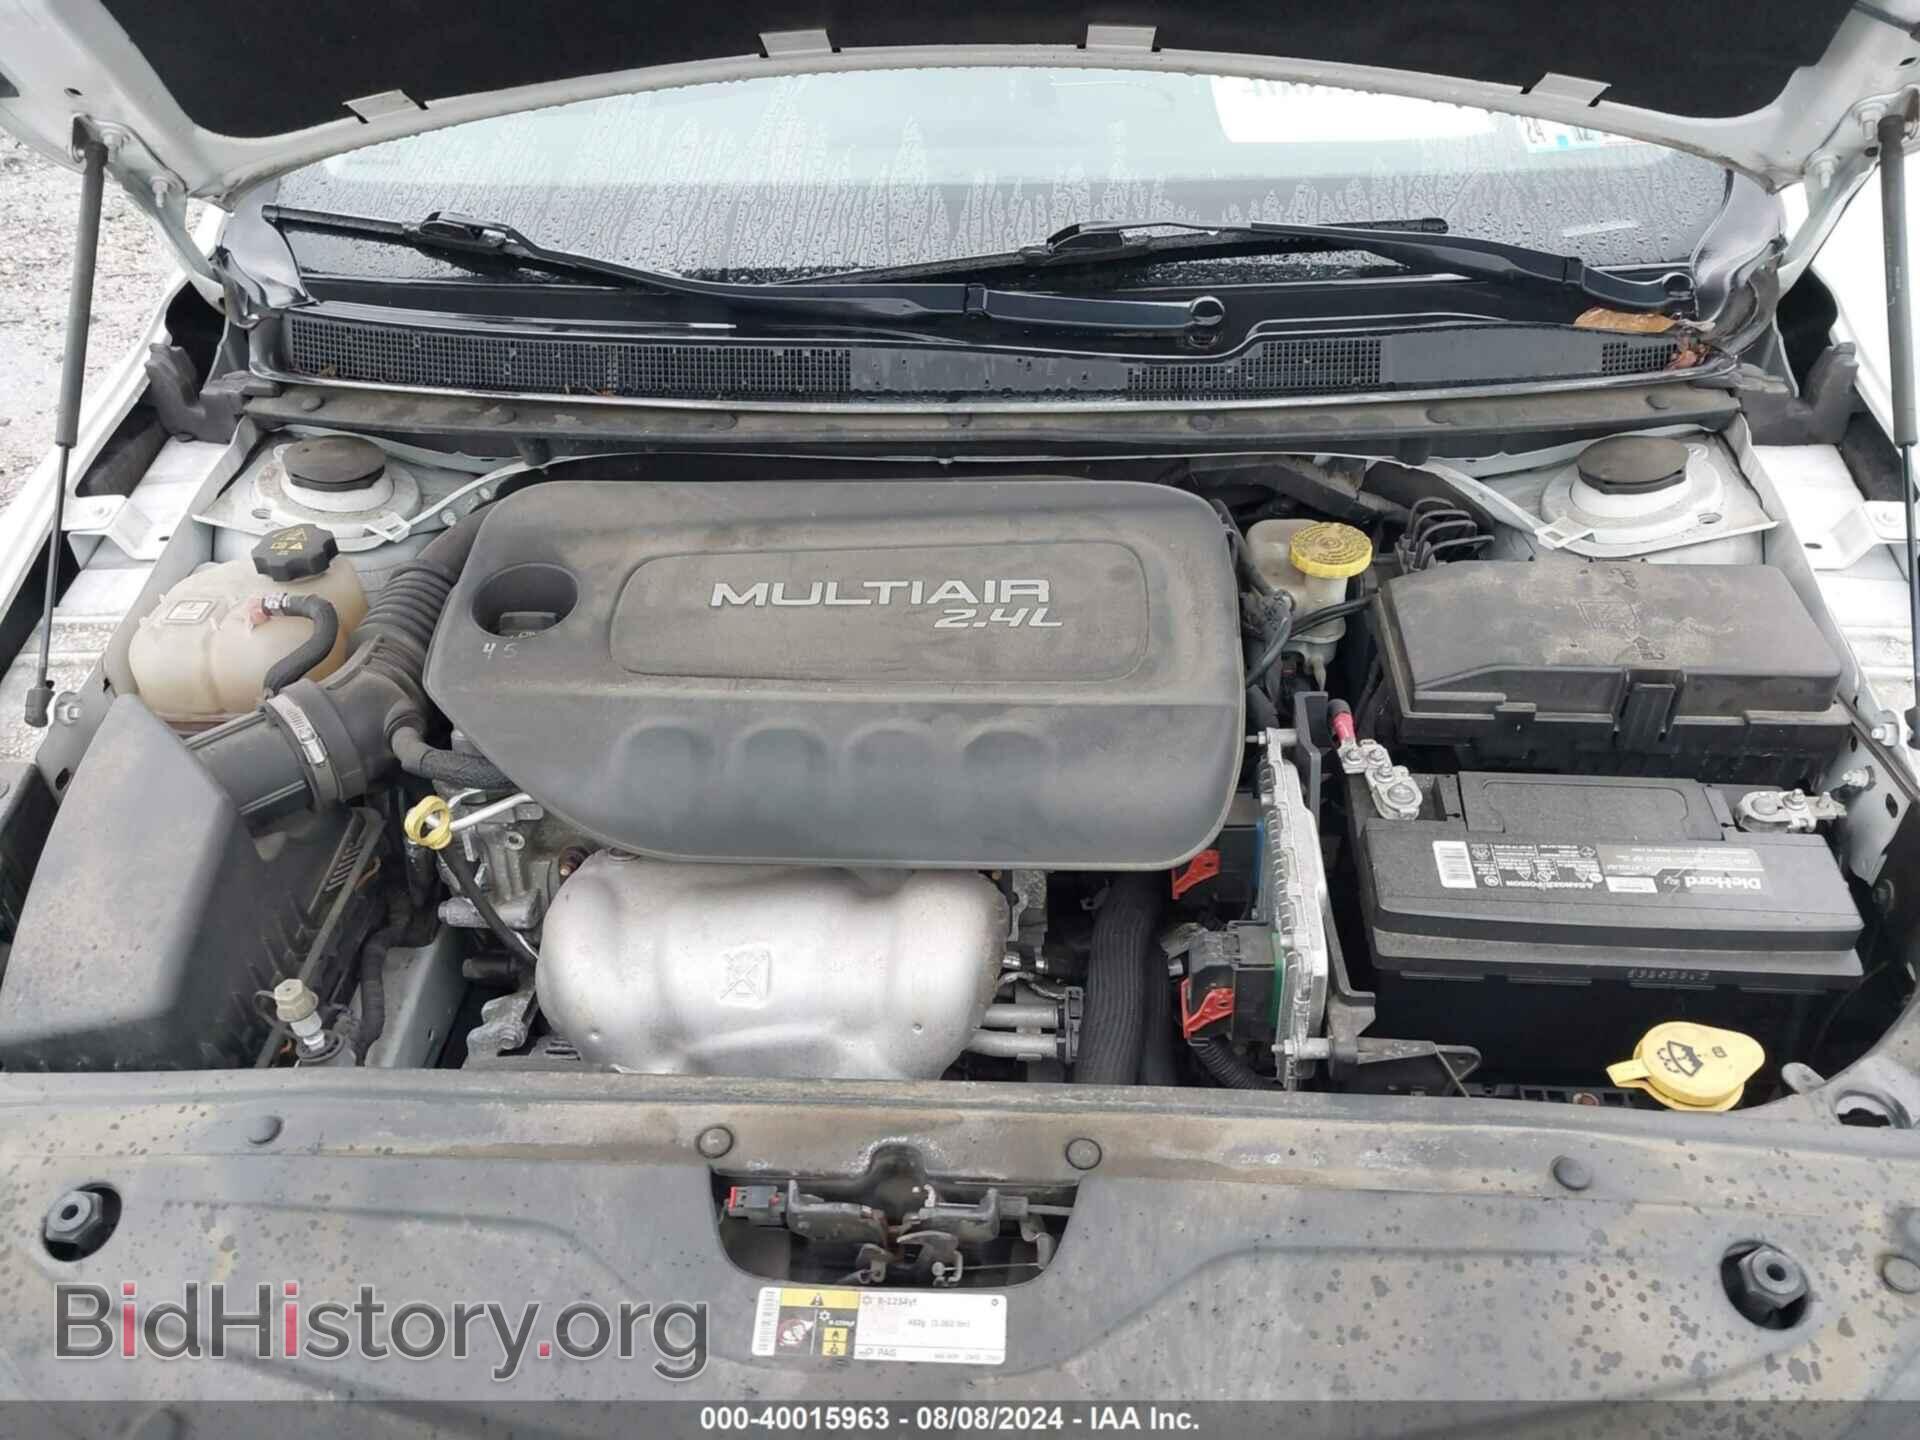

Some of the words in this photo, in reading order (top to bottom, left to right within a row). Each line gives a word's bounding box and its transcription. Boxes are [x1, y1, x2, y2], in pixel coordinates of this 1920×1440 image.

[710, 579, 1051, 607] MULTIAIR
[934, 607, 1064, 629] 2.4L
[1684, 875, 1762, 890] DieHard
